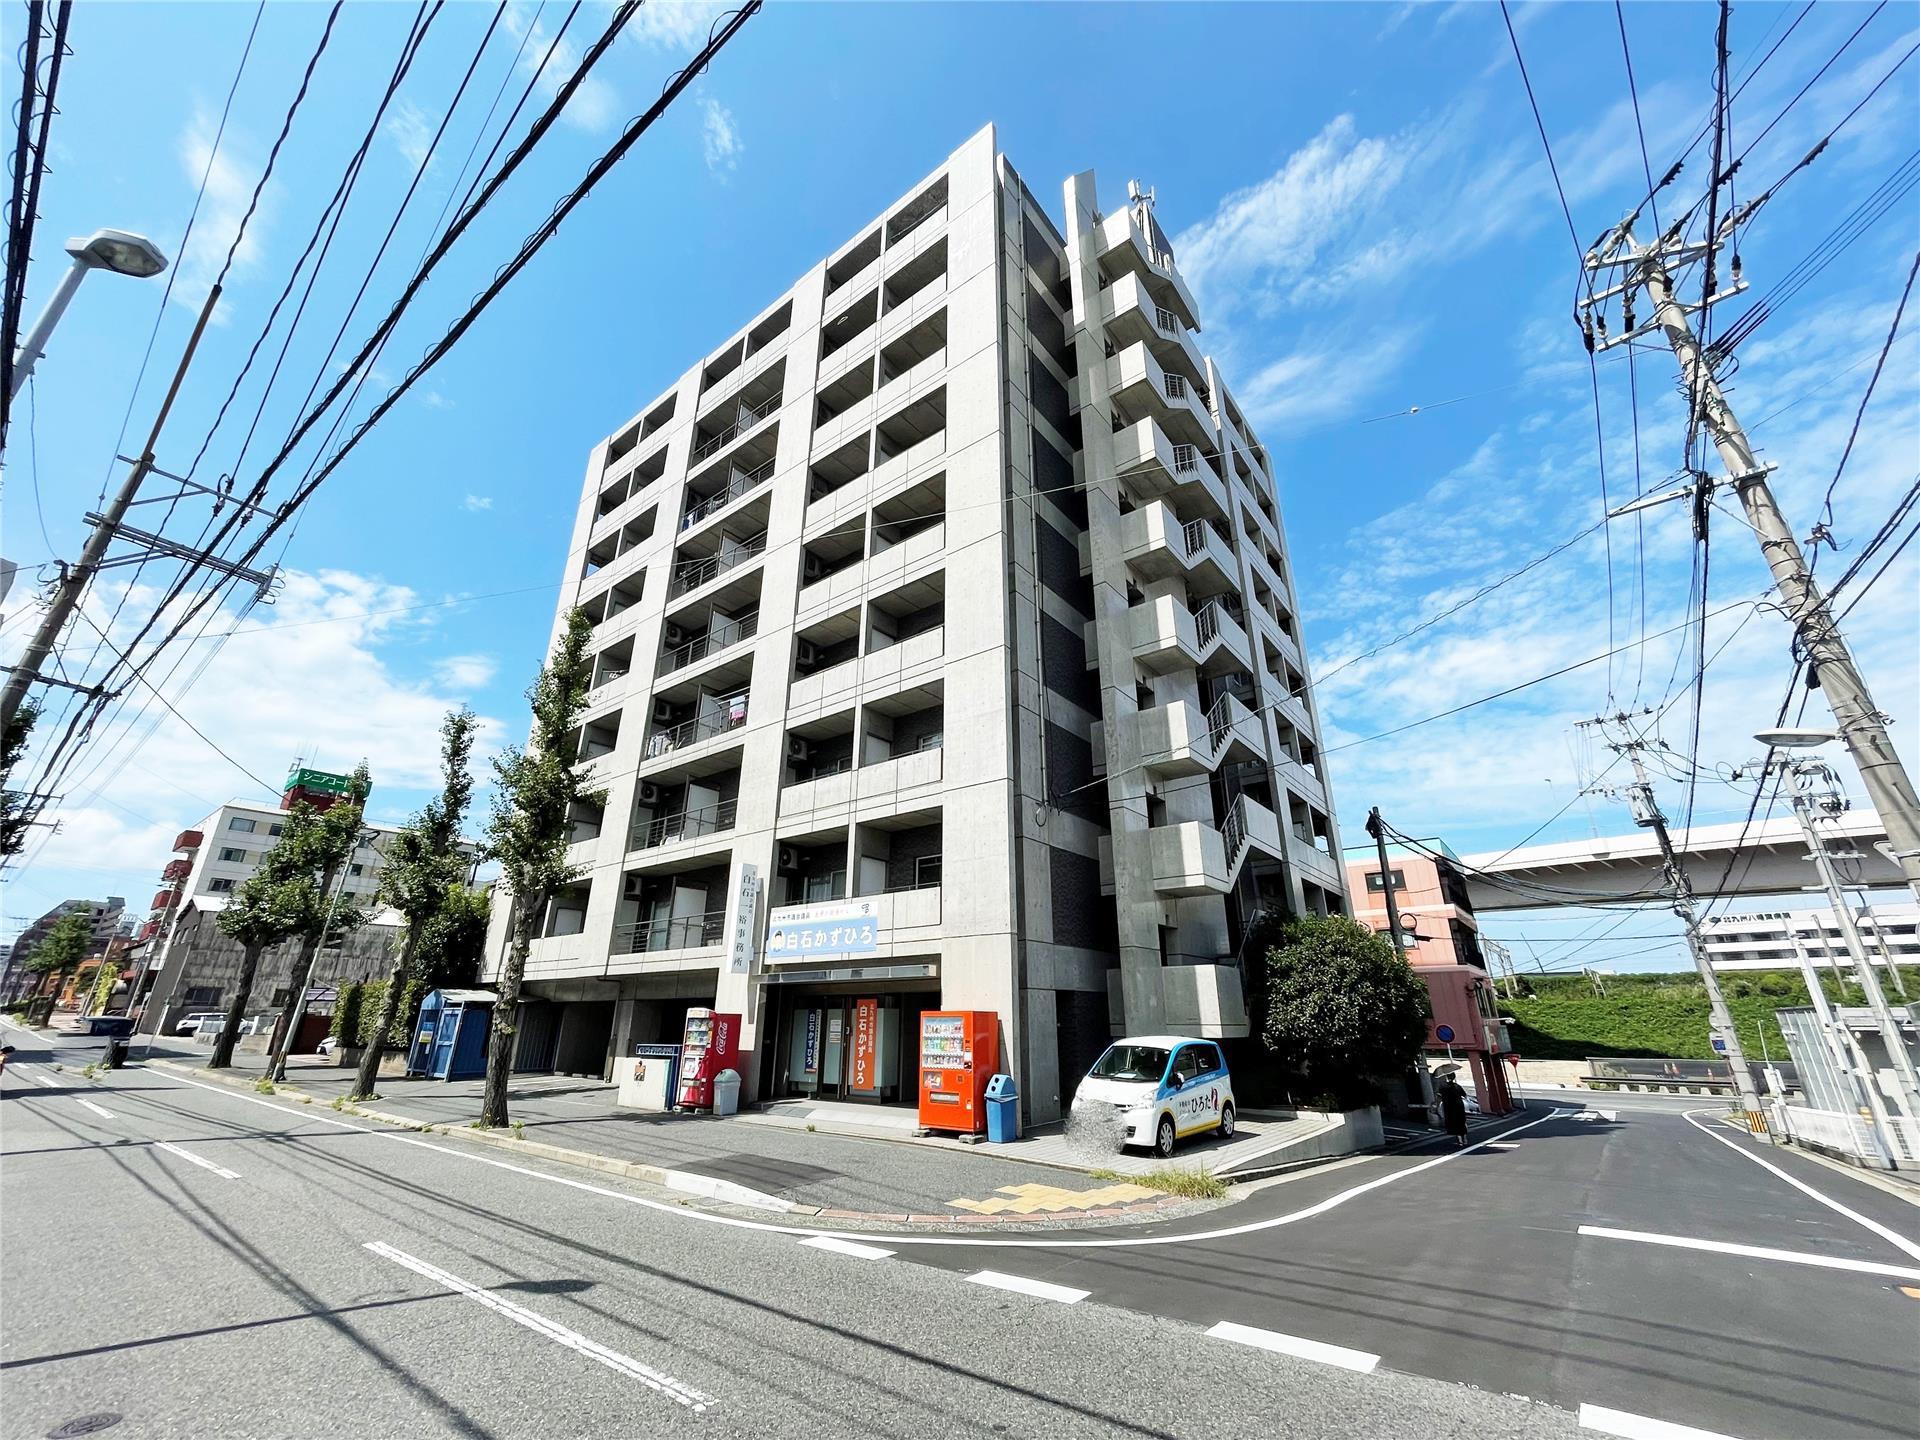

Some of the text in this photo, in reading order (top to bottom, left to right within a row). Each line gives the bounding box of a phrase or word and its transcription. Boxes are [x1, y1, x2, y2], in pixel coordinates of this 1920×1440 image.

[787, 925, 872, 950] 白石かずひろ
[857, 1005, 868, 1085] 白石かずひろ
